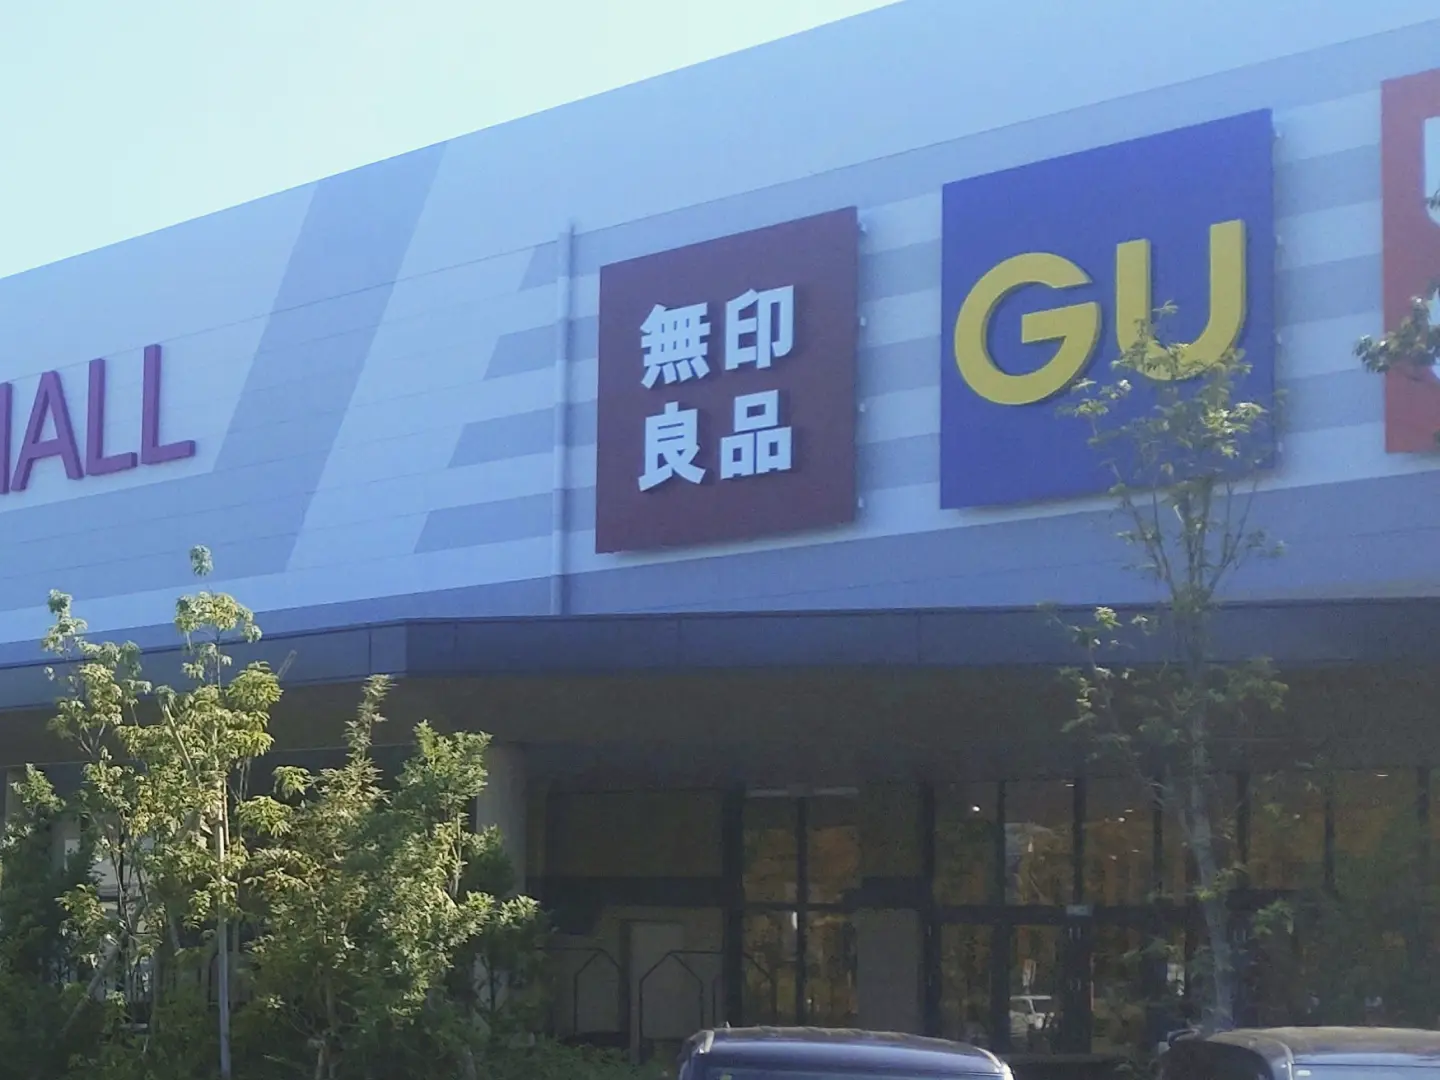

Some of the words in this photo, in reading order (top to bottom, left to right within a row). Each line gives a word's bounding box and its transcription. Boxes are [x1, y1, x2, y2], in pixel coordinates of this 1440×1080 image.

[640, 284, 795, 390] 無印
[954, 218, 1246, 406] GU
[637, 389, 793, 492] 良品
